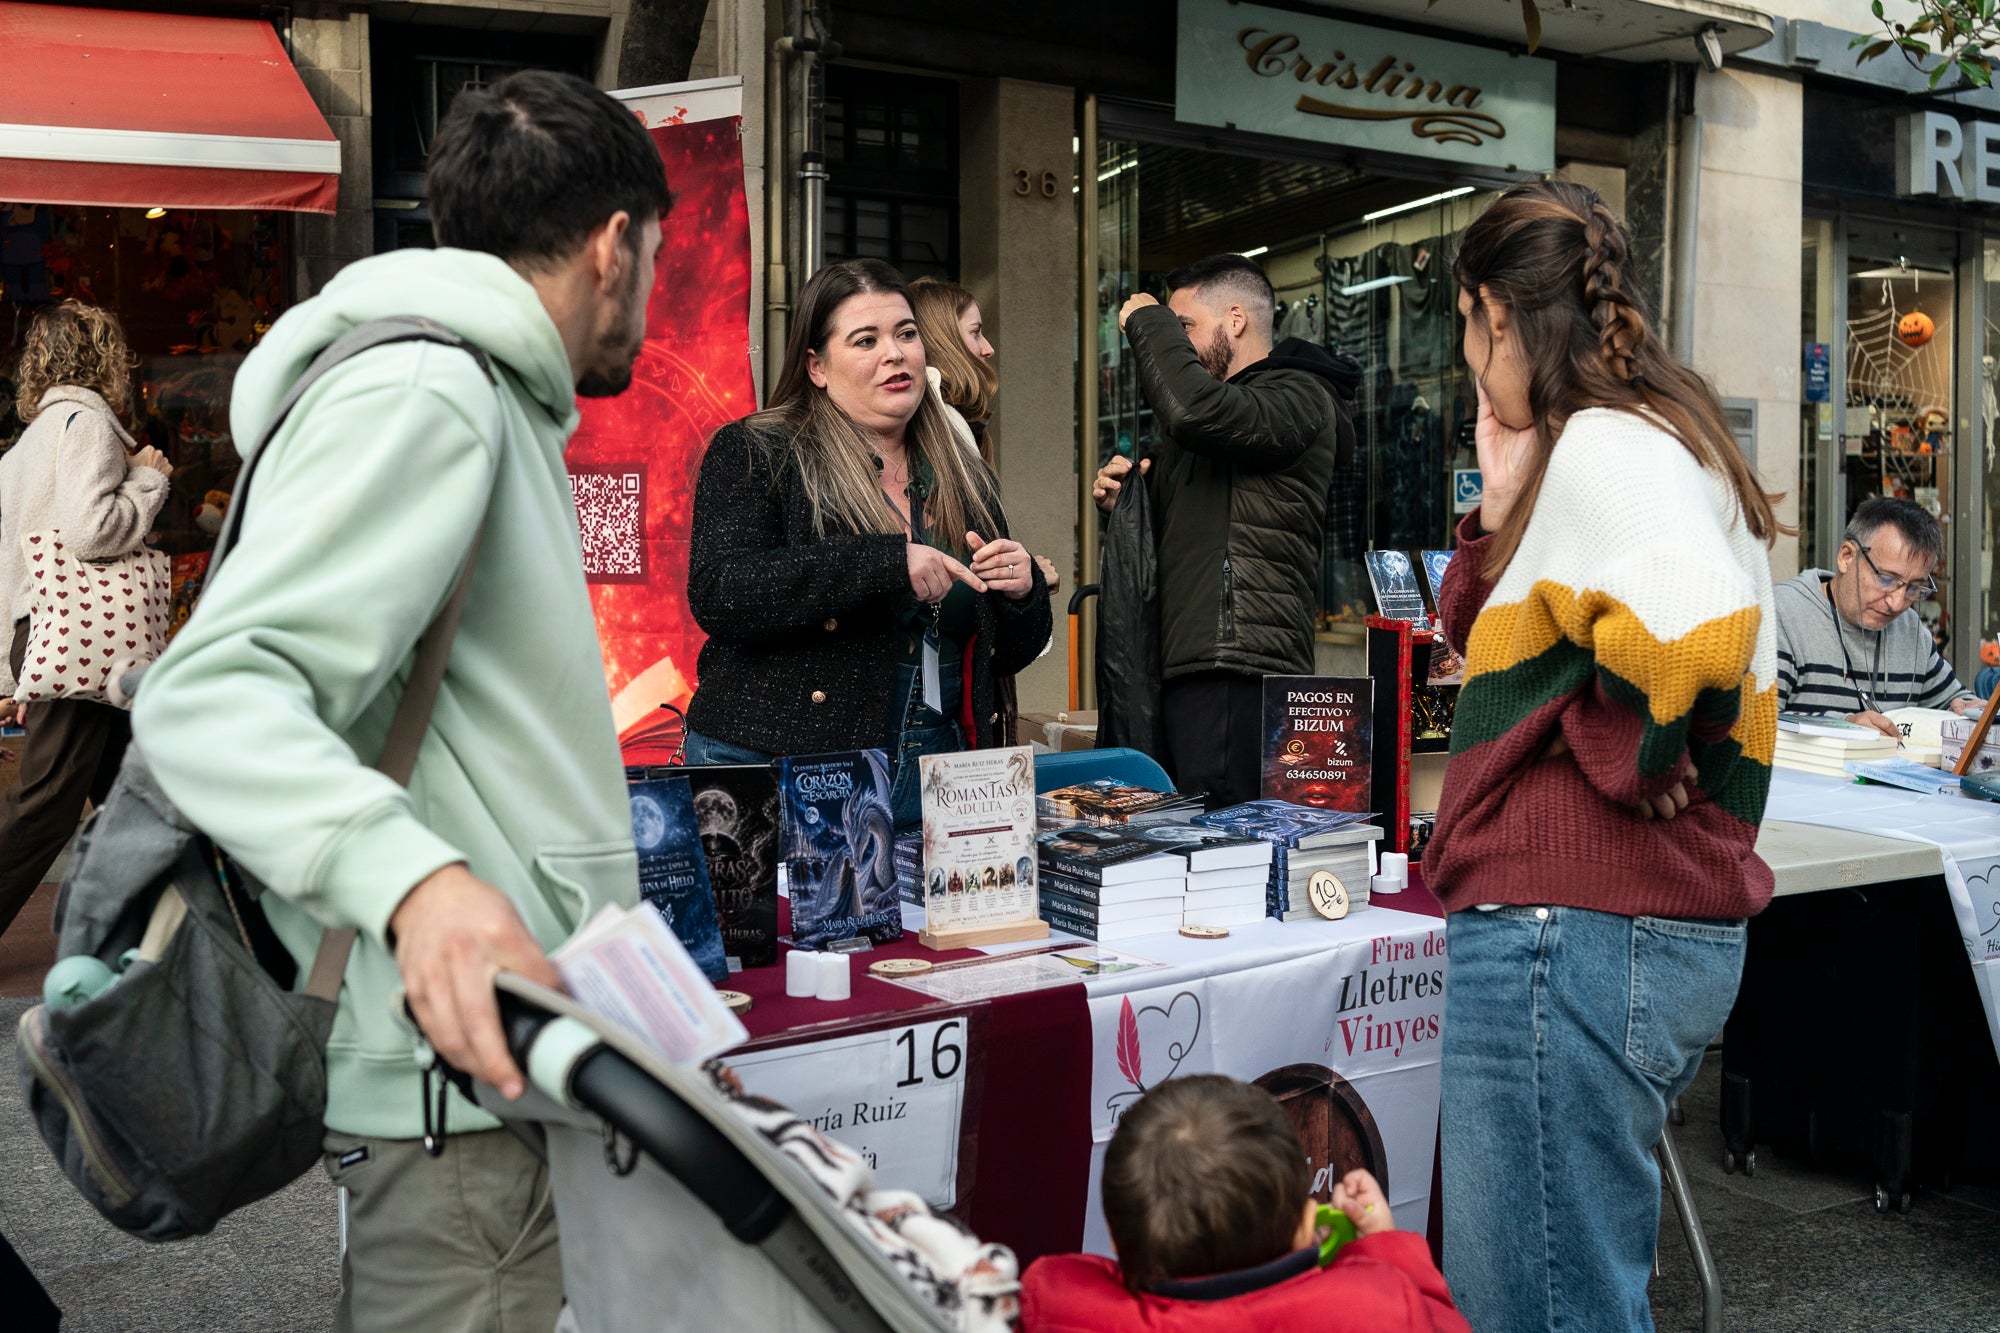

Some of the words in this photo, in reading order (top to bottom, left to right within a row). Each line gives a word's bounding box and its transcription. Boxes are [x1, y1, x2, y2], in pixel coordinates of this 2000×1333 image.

[1236, 25, 1485, 109] Cristina
[1013, 167, 1059, 198] 36
[1287, 692, 1333, 704] PAGOS
[1336, 693, 1354, 704] EN
[1288, 706, 1342, 717] EFECTIVO
[1344, 709, 1352, 717] Y
[1294, 719, 1344, 732] BIZUM
[1327, 757, 1353, 766] bizum
[796, 771, 853, 793] CORAZÓN
[1286, 769, 1347, 780] 634650891
[809, 789, 851, 802] ESCARCHA
[935, 780, 1020, 808] ROMANTASY
[956, 801, 1003, 816] ADULTA
[1056, 862, 1072, 872] María
[1072, 866, 1084, 876] Ruiz
[1084, 869, 1100, 880] Heras
[640, 880, 660, 893] EINA
[1054, 880, 1068, 891] María
[1069, 884, 1080, 894] Ruiz
[1081, 888, 1096, 899] Heras
[1052, 900, 1066, 911] María
[1067, 904, 1079, 914] Ruiz
[1079, 908, 1095, 919] Heras
[846, 915, 864, 928] RUIZ
[865, 913, 889, 926] HERAS
[1052, 916, 1067, 927] María
[1068, 921, 1079, 931] Ruiz
[1080, 925, 1095, 936] Heras
[1370, 936, 1416, 966] Fira
[1423, 930, 1446, 958] de
[1336, 967, 1443, 1014] Lletres
[1337, 1014, 1440, 1058] Vinyes
[896, 1021, 962, 1088] 16
[802, 1108, 842, 1132] aría
[852, 1096, 907, 1126] Ruiz
